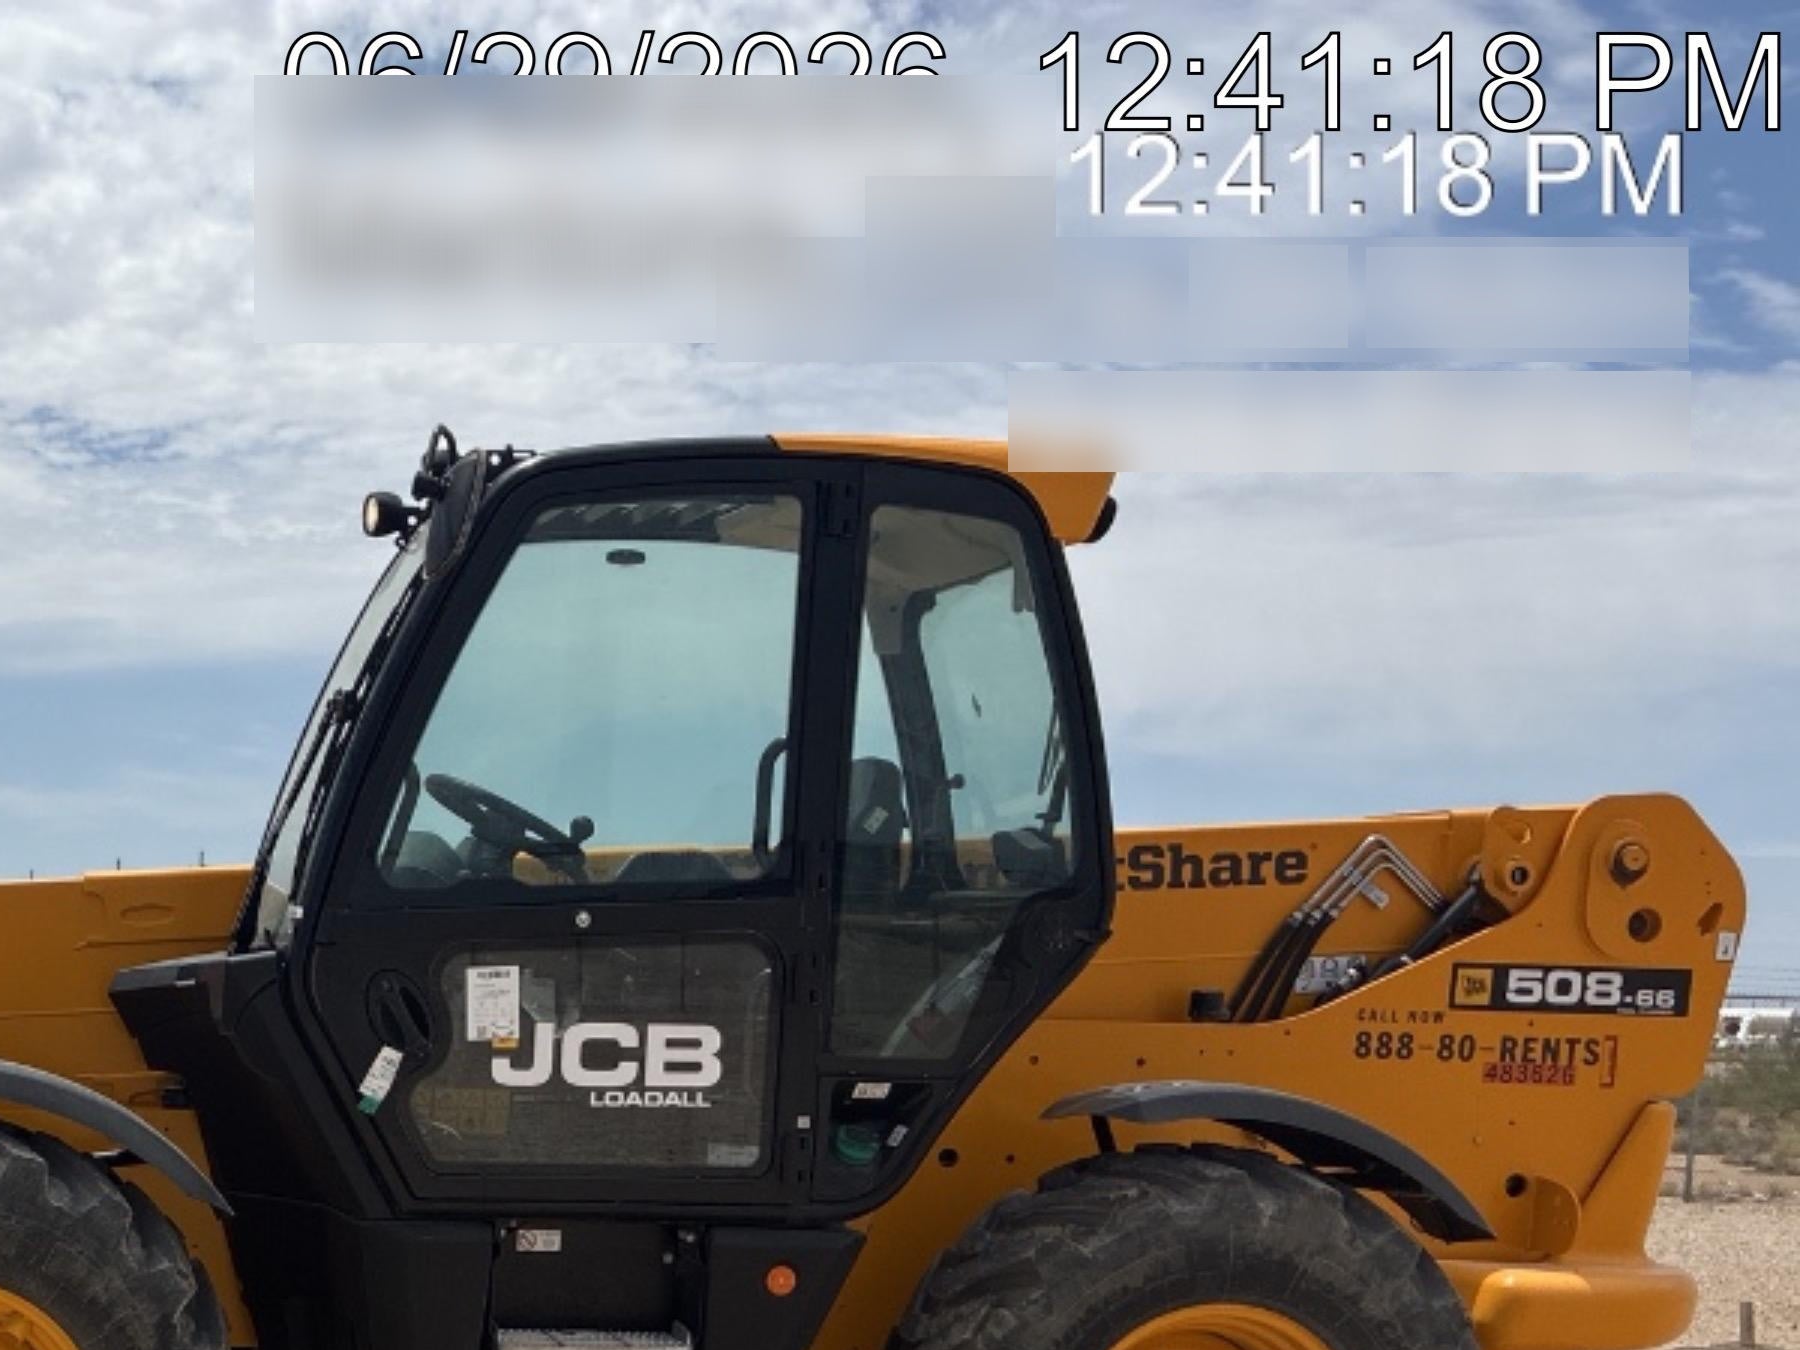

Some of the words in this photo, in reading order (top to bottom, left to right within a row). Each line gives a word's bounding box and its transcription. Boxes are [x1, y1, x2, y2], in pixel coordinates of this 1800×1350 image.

[1115, 842, 1309, 891] Share
[1356, 1008, 1399, 1023] CALL
[1407, 1009, 1446, 1024] NOW
[491, 1022, 722, 1087] JCB
[589, 1090, 713, 1108] LOADALL
